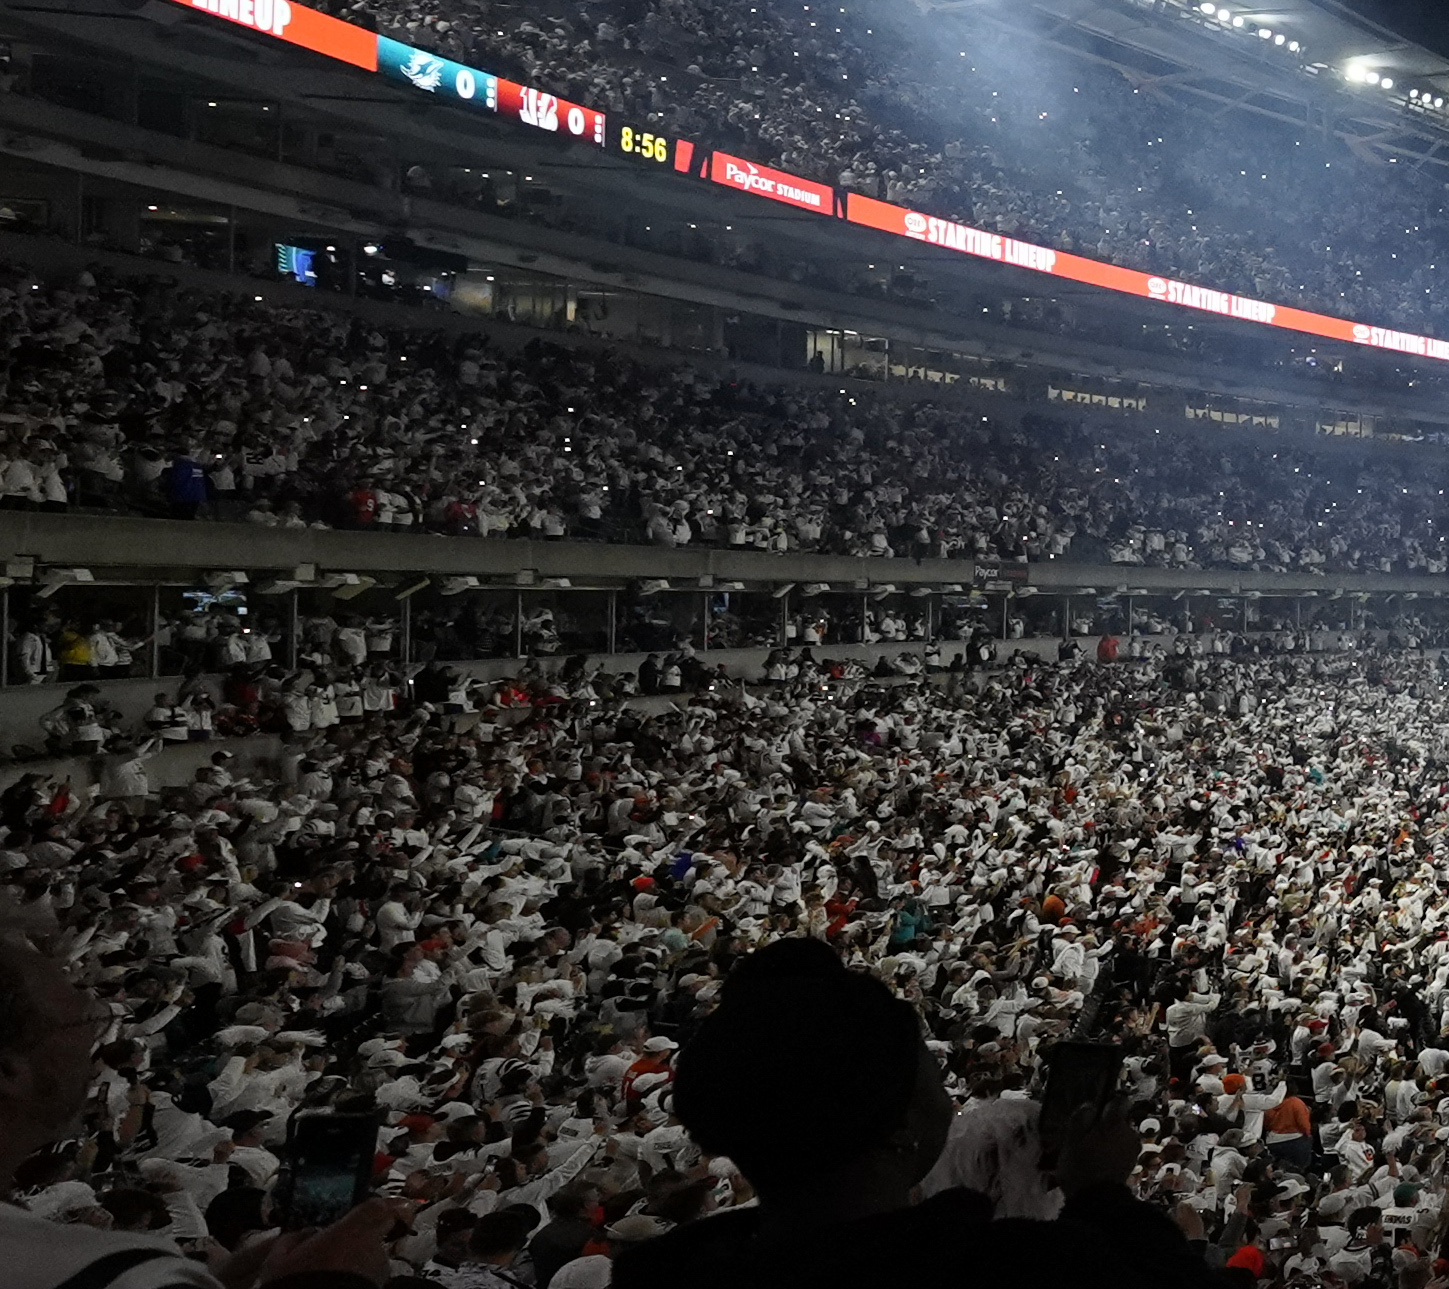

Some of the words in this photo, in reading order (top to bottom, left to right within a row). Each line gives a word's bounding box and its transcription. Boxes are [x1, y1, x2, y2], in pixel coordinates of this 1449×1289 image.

[457, 71, 477, 99] 0
[569, 108, 586, 134] 0
[622, 127, 667, 162] 8:56
[726, 162, 775, 190] Paycor
[777, 182, 821, 206] STADIUM
[929, 218, 1002, 260] STARTING
[1006, 238, 1058, 272] LINEUP
[1169, 281, 1229, 314] STARTING
[1231, 295, 1277, 325] LINEUP
